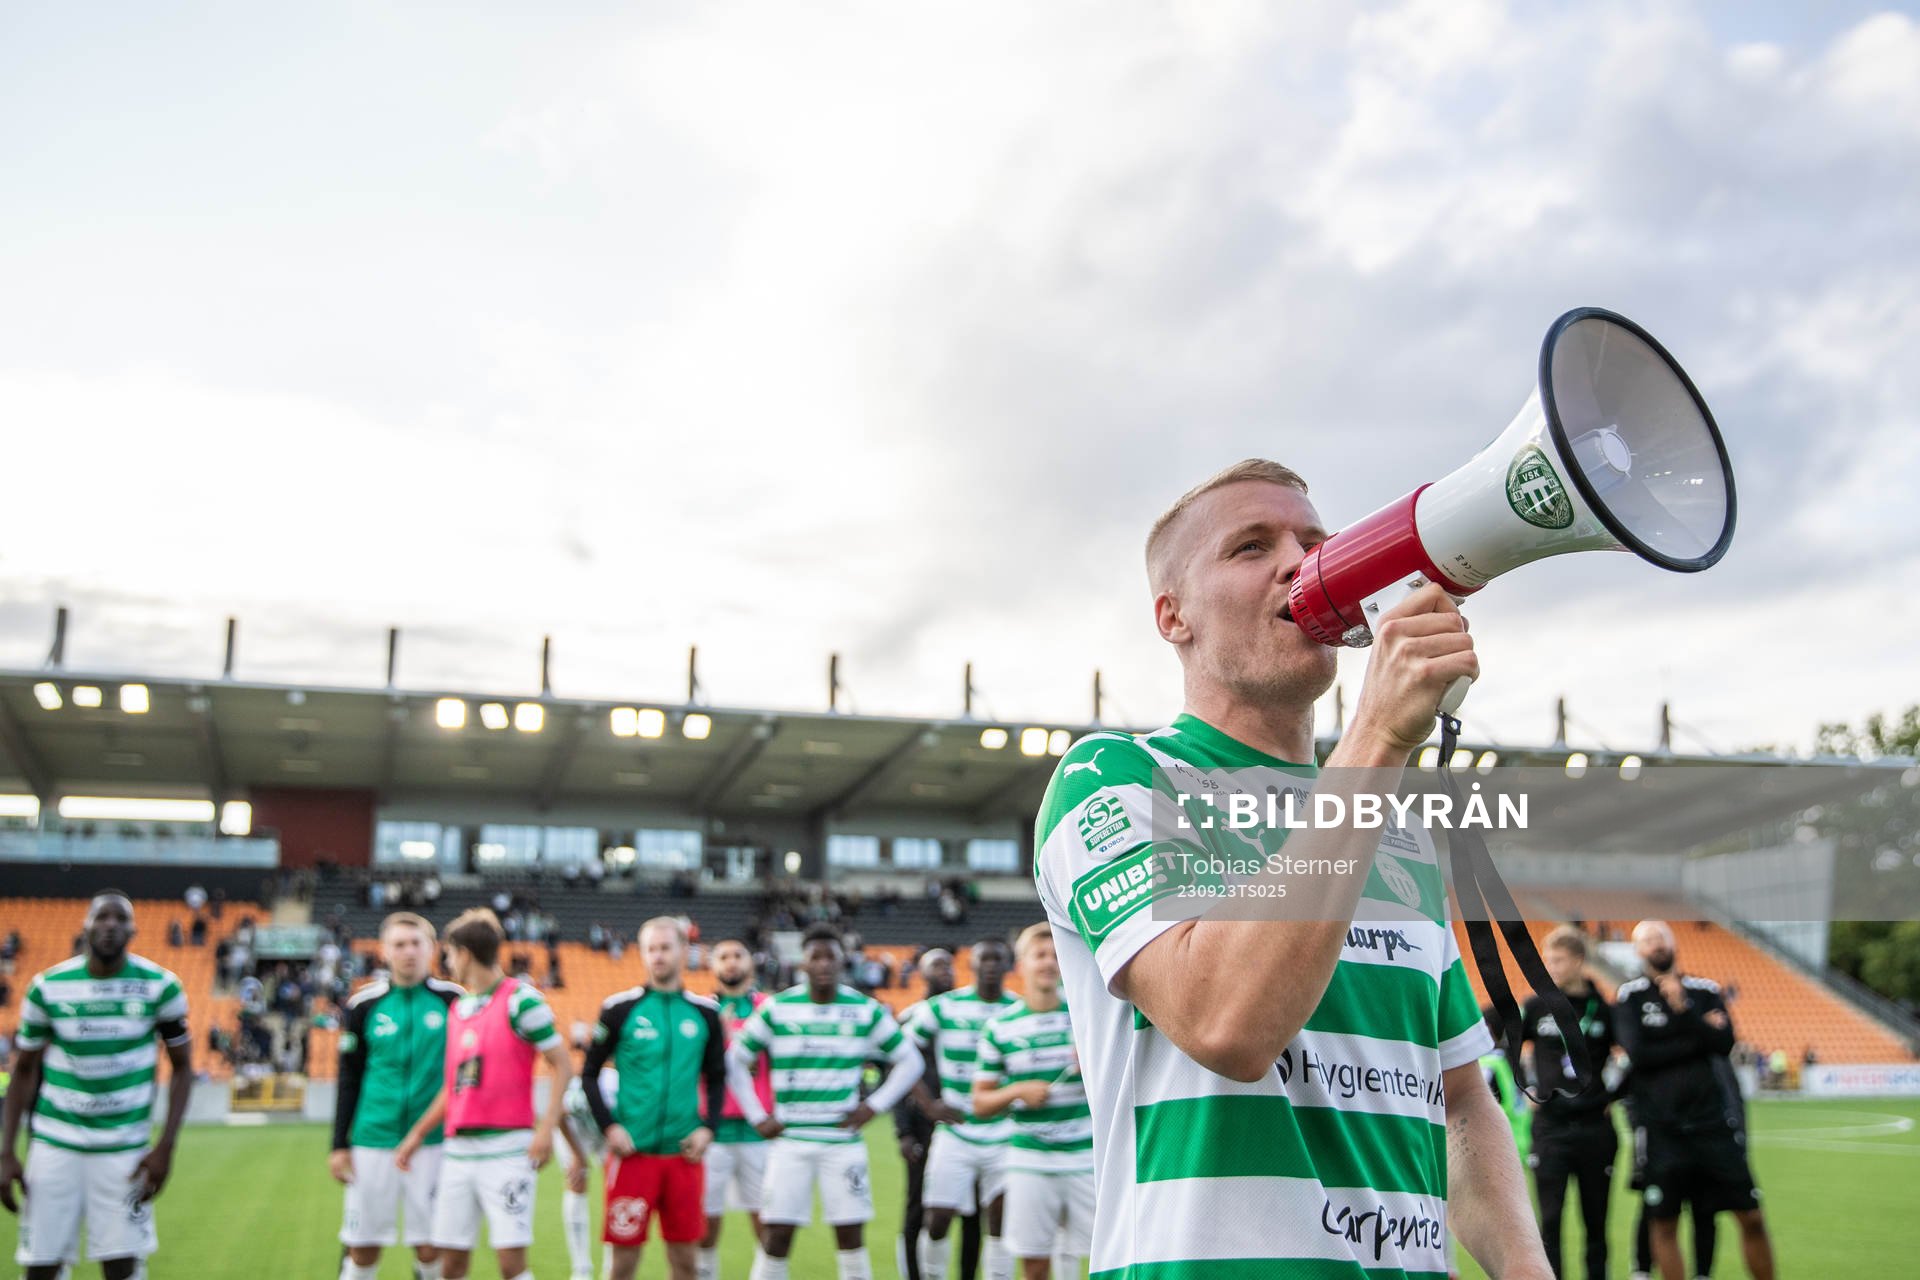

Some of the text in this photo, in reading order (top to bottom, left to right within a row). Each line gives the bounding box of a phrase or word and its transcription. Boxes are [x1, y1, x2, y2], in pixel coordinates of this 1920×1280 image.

[1522, 469, 1541, 481] VSK
[1090, 819, 1125, 847] SUPERETTAN
[1084, 851, 1176, 911] UNIBET
